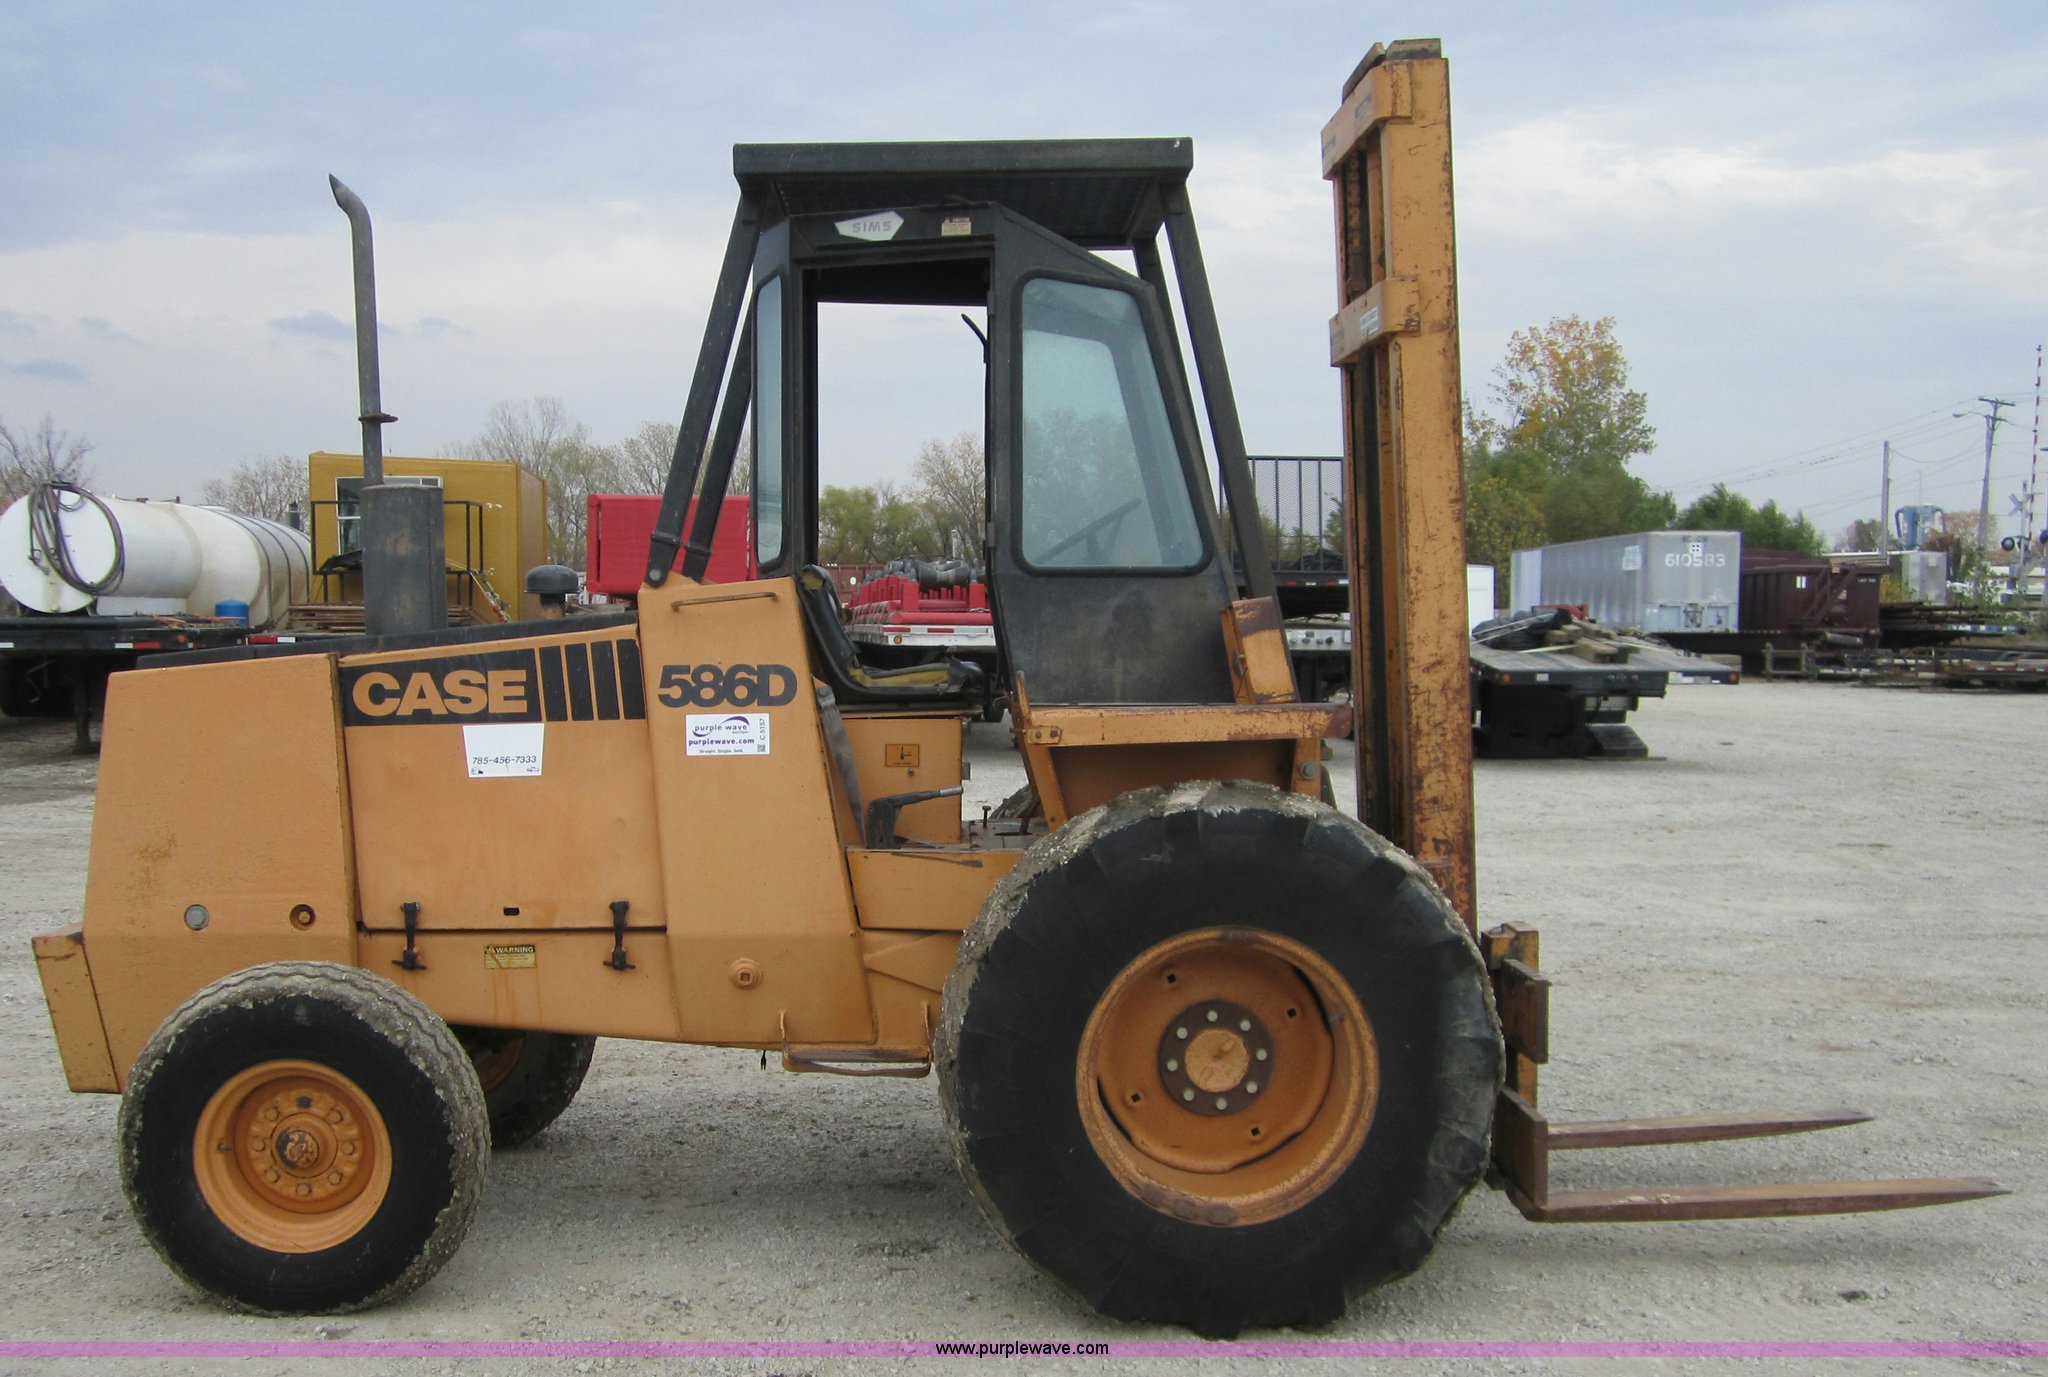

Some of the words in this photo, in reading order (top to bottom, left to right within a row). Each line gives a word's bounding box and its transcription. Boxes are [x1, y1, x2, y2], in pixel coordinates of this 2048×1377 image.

[852, 220, 892, 233] SIMS
[658, 663, 798, 708] 586D
[352, 669, 528, 717] CASE
[694, 724, 723, 733] purple
[688, 737, 755, 746] purplewave.com
[472, 755, 537, 765] 785-456-7333
[495, 946, 534, 954] WARNING
